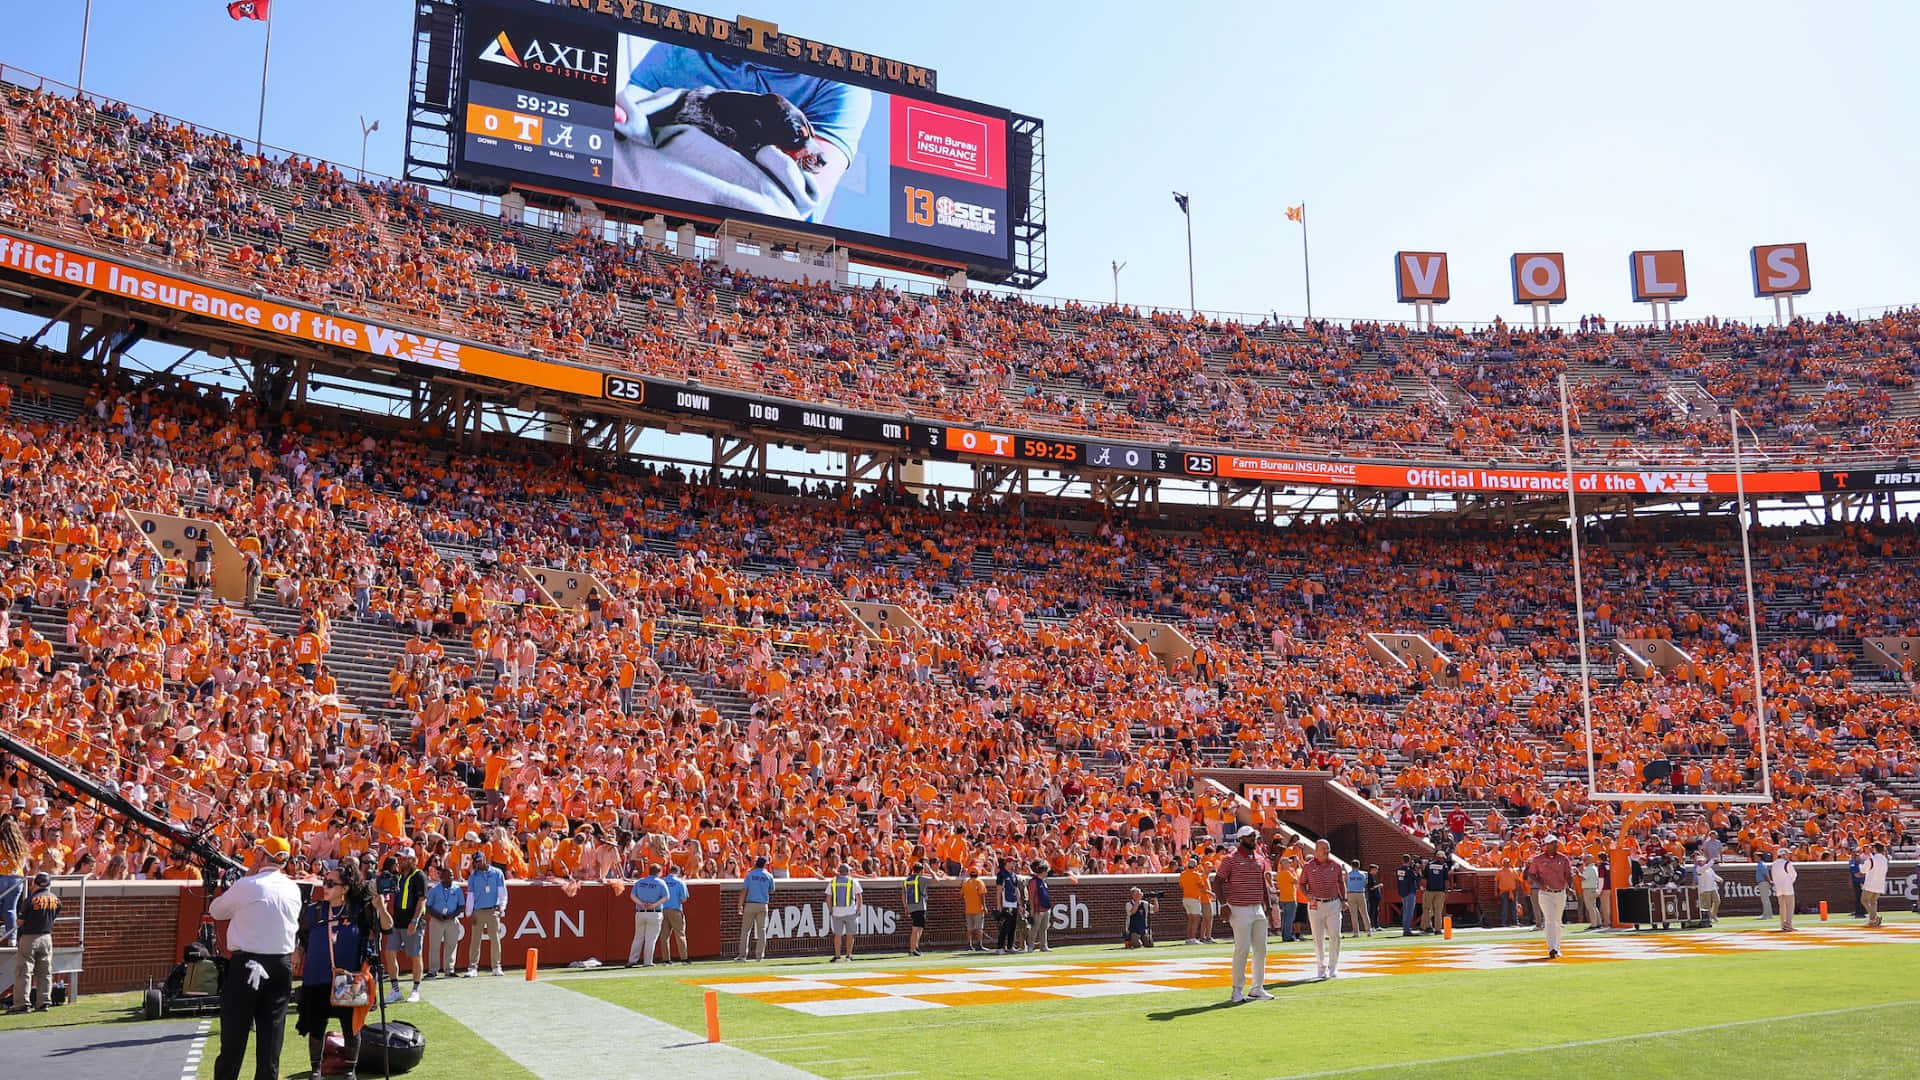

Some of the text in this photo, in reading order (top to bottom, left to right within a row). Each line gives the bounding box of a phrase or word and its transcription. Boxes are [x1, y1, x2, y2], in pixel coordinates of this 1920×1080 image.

[571, 0, 927, 87] NEYLAND T STADIUM
[523, 39, 609, 76] AXLE
[524, 62, 608, 84] LOGISTICS
[516, 94, 570, 117] 59:25
[484, 114, 498, 130] 0
[513, 115, 539, 141] T
[588, 134, 602, 150] 0
[918, 130, 976, 151] Farm Bureau
[477, 137, 498, 146] DOWN
[513, 143, 522, 151] TO
[549, 150, 564, 158] BALL
[917, 141, 976, 160] INSURANCE
[592, 165, 600, 177] 1
[904, 186, 934, 227] 13
[955, 202, 995, 224] SEC
[109, 267, 261, 325] Insurance
[272, 312, 300, 333] of
[312, 316, 357, 345] the
[611, 380, 639, 398] 25
[677, 392, 910, 440] DOWN TO GO BALL ON QTR 1
[930, 435, 938, 445] 3
[962, 433, 1008, 455] 0 T
[1025, 441, 1077, 460] 59:25
[1125, 450, 1139, 466] 0
[1158, 459, 1166, 469] 3
[1189, 457, 1212, 471] 25
[1232, 458, 1356, 475] Farm Bureau INSURANCE
[1406, 469, 1474, 487] Official
[1481, 472, 1569, 490] Insurance
[1579, 474, 1598, 490] of
[1604, 474, 1636, 490] the
[1833, 473, 1849, 488] T
[1875, 473, 1920, 484] FIRST
[461, 853, 472, 870] 16
[1724, 881, 1777, 898] fitne
[818, 902, 897, 939] JHNS
[1047, 894, 1089, 930] sh
